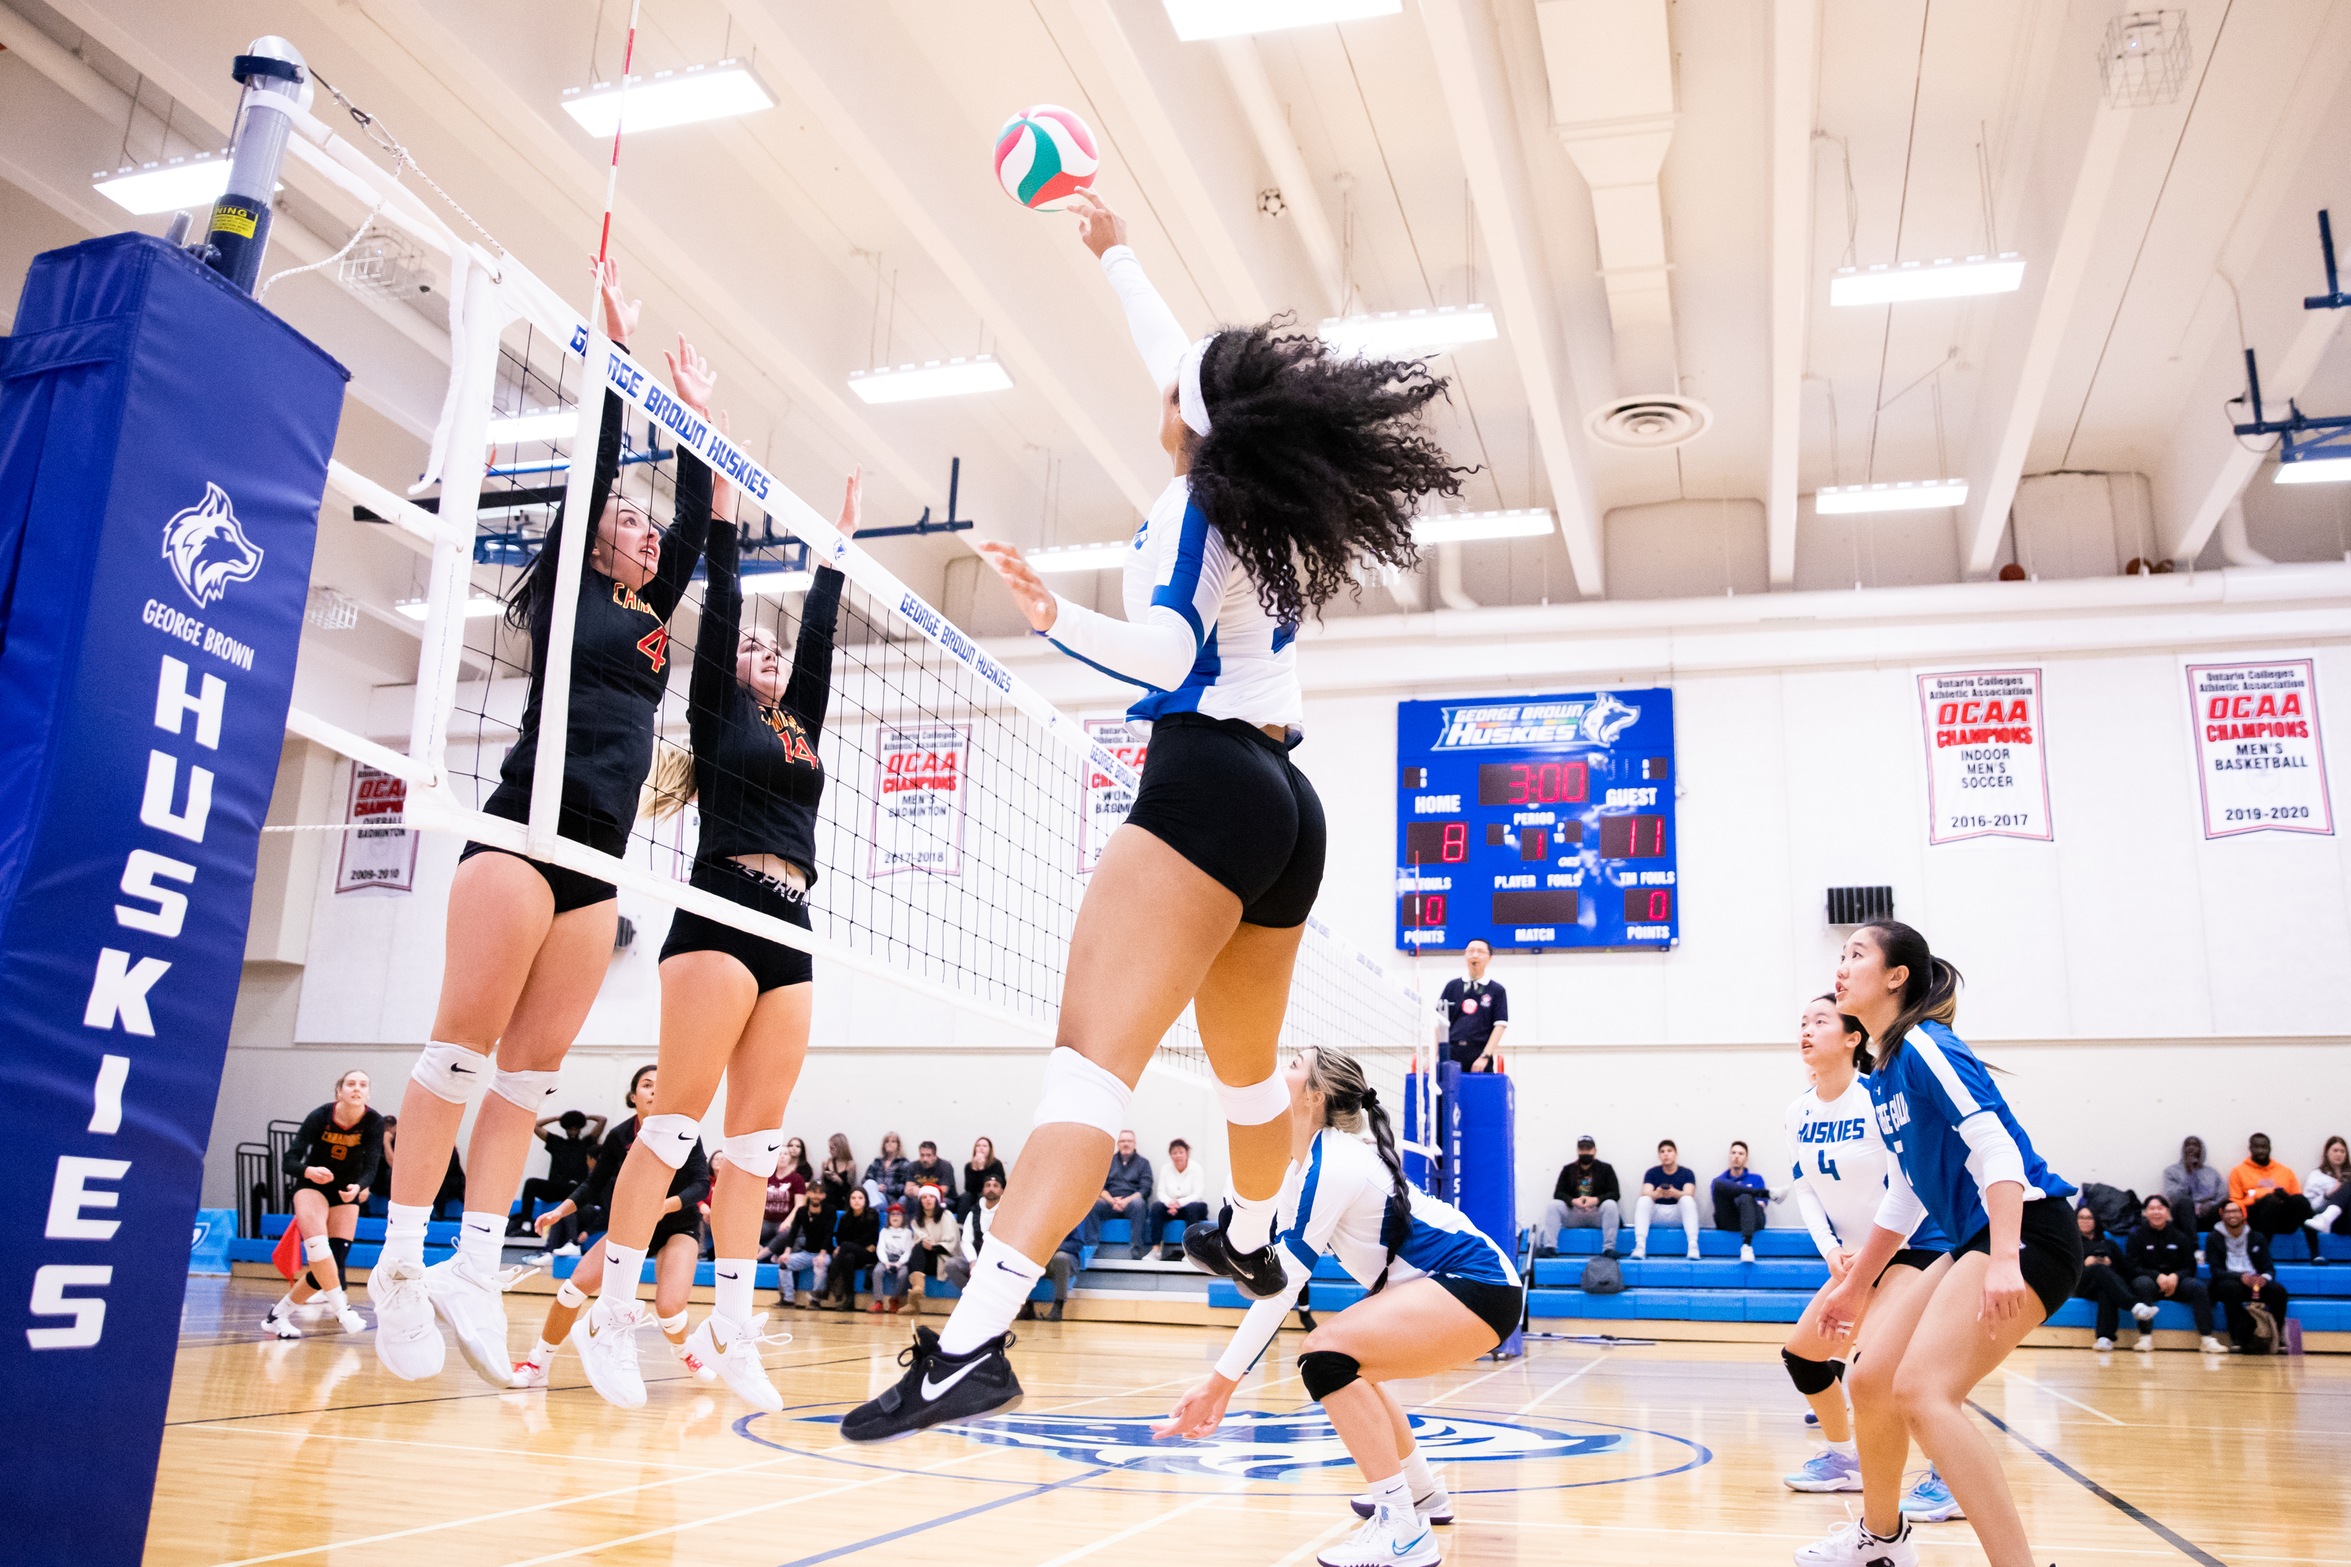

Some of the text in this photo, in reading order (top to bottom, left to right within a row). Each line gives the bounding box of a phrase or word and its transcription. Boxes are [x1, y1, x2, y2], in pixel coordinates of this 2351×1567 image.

[216, 206, 248, 218] NING
[570, 324, 771, 501] GRGE BROWN HUSKIES
[142, 598, 255, 671] GEORGE BROWN
[900, 592, 1012, 694] GEORGE BROWN HUSKIES
[636, 625, 669, 674] 4
[1453, 703, 1586, 723] GEORGE BROWN
[1937, 699, 2028, 725] OCAA
[2208, 692, 2301, 719] OCAA
[1936, 726, 2033, 749] CHAMPIONS
[2206, 720, 2309, 743] CHAMPIONS
[776, 729, 819, 770] 14
[1960, 748, 2011, 762] INDOOR
[2236, 742, 2284, 756] MEN'S
[886, 750, 957, 774] OCAA
[1967, 762, 2007, 775] MEN'S
[2215, 756, 2309, 771] BASKETBALL
[1508, 762, 1587, 804] 3:00
[1961, 775, 2014, 789] SOCCER
[1414, 794, 1462, 814] HOME
[1605, 787, 1658, 807] GUEST
[1513, 812, 1556, 826] PERIOD
[1951, 814, 2028, 828] 2016-2017
[2225, 806, 2310, 821] 2019-2020
[1441, 822, 1467, 863] 8
[1536, 832, 1544, 859] 1
[1629, 819, 1663, 856] 11
[350, 868, 400, 880] 2009-2010
[1417, 876, 1452, 891] FOULS
[1494, 873, 1582, 889] PLAYER FOULS
[1640, 871, 1676, 886] FOULS
[1424, 895, 1444, 925] 0
[1649, 889, 1668, 921] 0
[1403, 929, 1446, 944] POINTS
[1514, 928, 1556, 942] MATCH
[1626, 925, 1671, 940] POINTS
[27, 653, 227, 1351] HUSKIES
[330, 1144, 348, 1161] 9
[1817, 1149, 1842, 1181] 4
